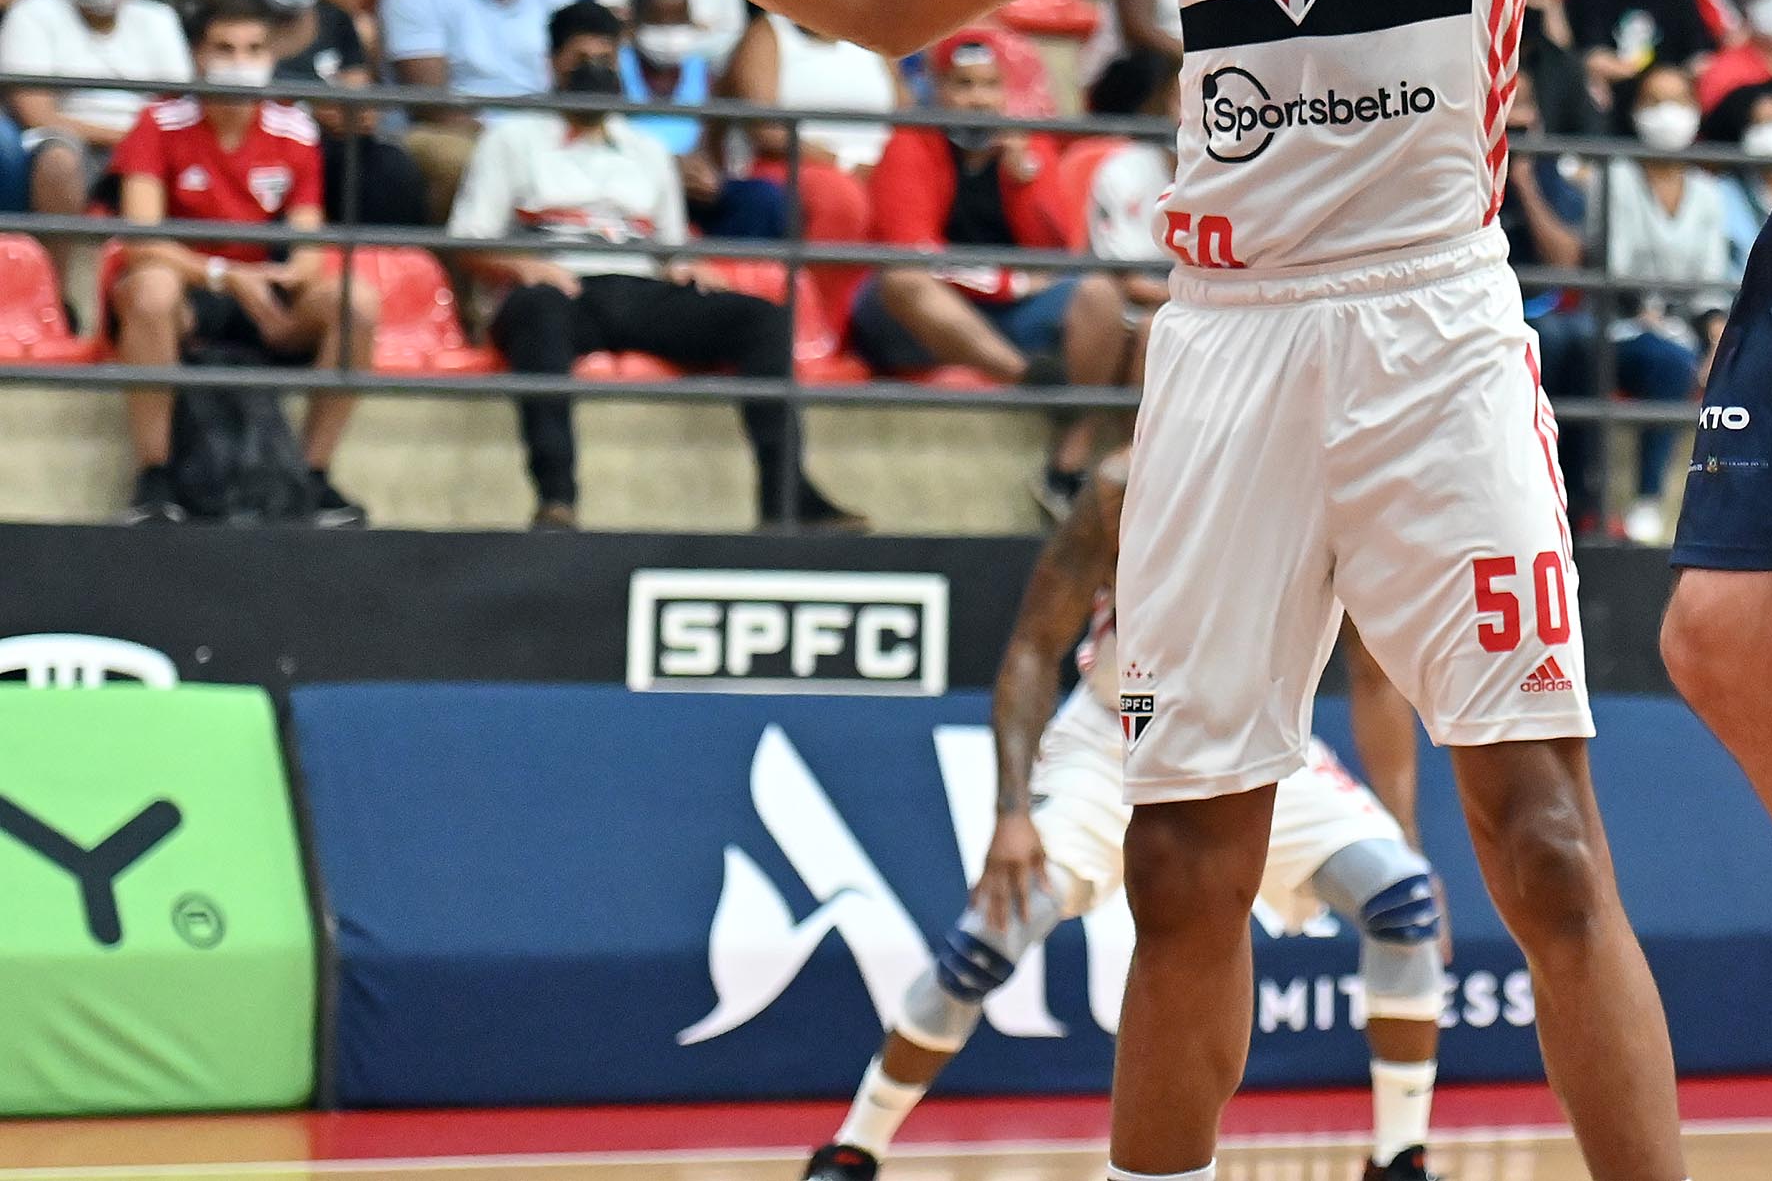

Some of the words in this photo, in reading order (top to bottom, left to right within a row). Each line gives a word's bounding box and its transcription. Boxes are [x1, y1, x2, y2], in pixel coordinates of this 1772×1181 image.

[1215, 80, 1436, 141] Sportsbet.io
[1163, 211, 1249, 269] 50
[1473, 551, 1571, 653] 50
[660, 601, 918, 679] SPFC
[1120, 698, 1152, 711] SPFC
[1520, 676, 1574, 693] adidas
